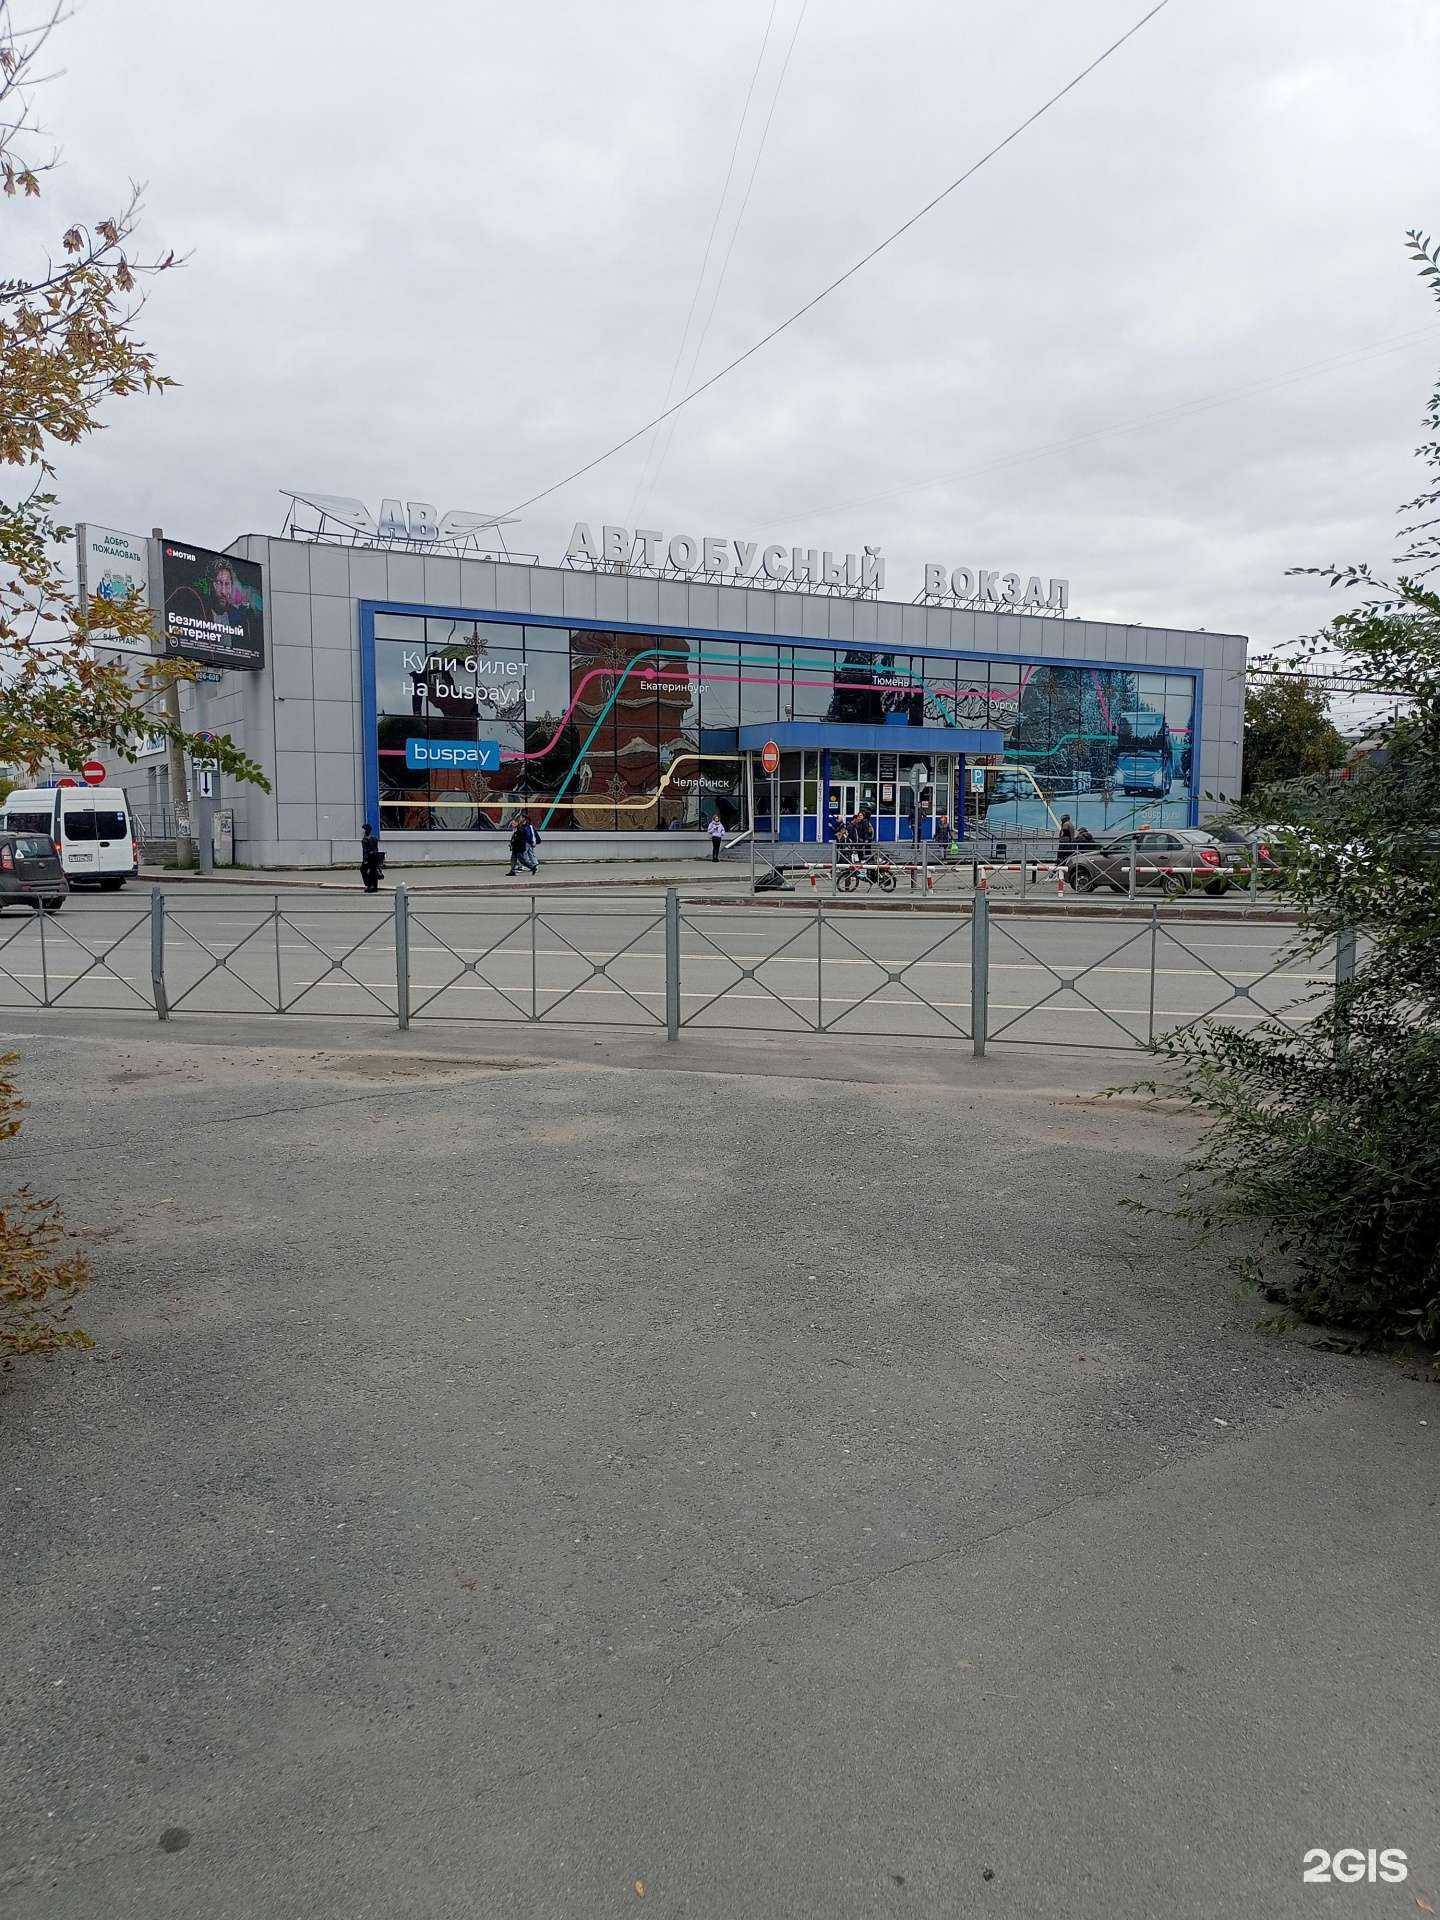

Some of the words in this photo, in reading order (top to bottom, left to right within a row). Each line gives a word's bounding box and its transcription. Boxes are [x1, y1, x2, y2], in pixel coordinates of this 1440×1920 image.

[104, 535, 129, 548] ДОБРО
[92, 543, 141, 561] ПОЖАЛОВАТЬ
[566, 522, 885, 589] АВТОБУСНЫЙ
[924, 563, 1069, 609] ВОКЗАЛ
[402, 651, 457, 674] Купи
[464, 655, 529, 676] билет
[640, 681, 710, 693] Екатеринбург
[872, 675, 909, 687] Тюмень
[402, 681, 429, 697] на
[435, 679, 536, 704] buspay.ru
[989, 700, 1020, 711] Сургут
[414, 743, 491, 766] buspay
[672, 777, 730, 788] Челябинск
